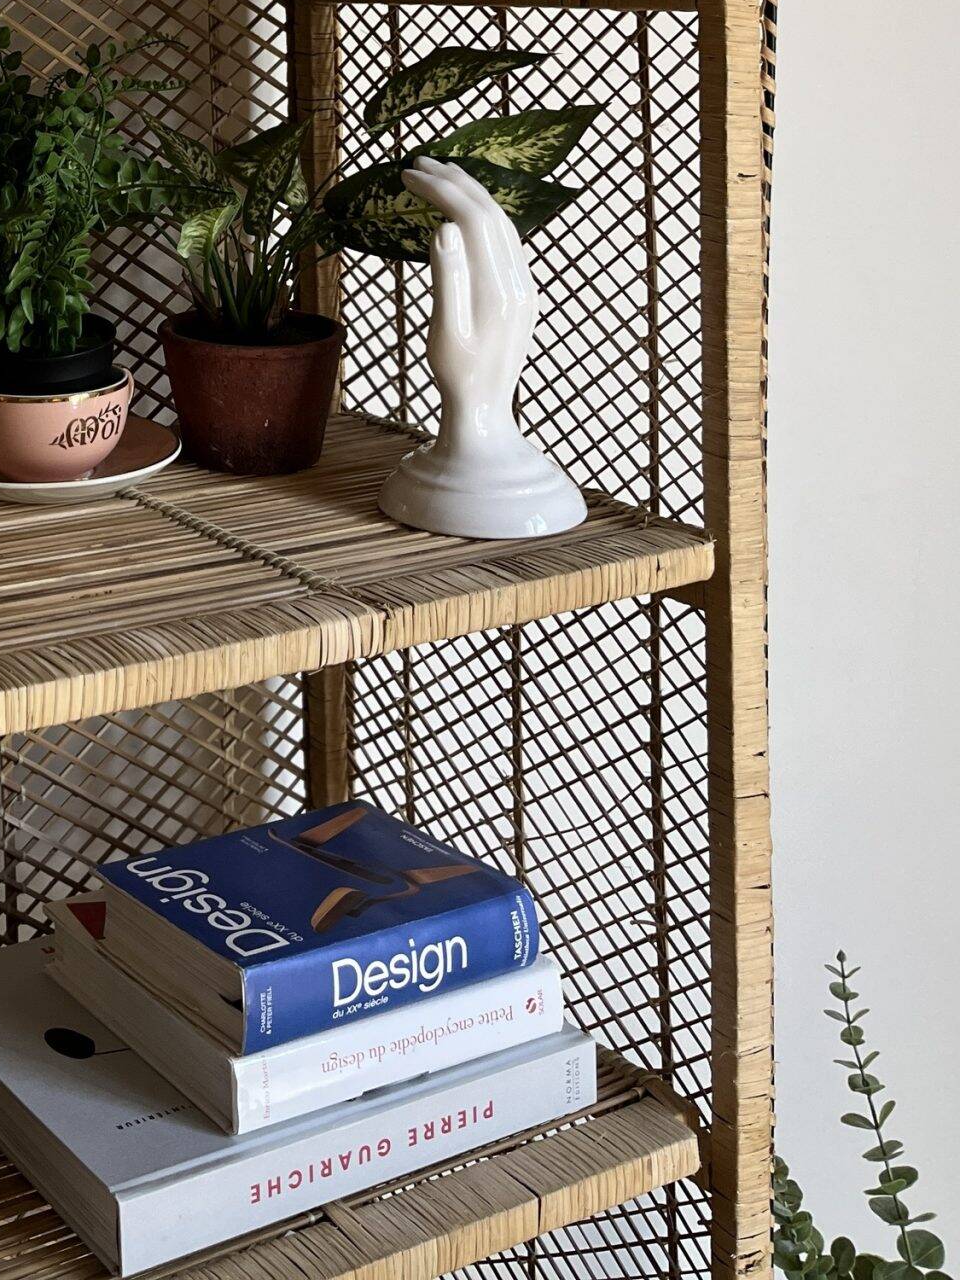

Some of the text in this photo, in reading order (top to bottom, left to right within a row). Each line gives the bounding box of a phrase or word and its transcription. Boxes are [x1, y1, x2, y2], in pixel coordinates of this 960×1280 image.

[126, 857, 290, 957] Design
[287, 930, 304, 943] du
[510, 910, 523, 961] TASCHEN
[332, 936, 468, 1007] Design
[321, 1005, 514, 1074] Petite encyclopédie du design
[332, 1007, 345, 1020] du
[363, 995, 389, 1010] siècle
[250, 1100, 494, 1204] PIERRE GUARICHE
